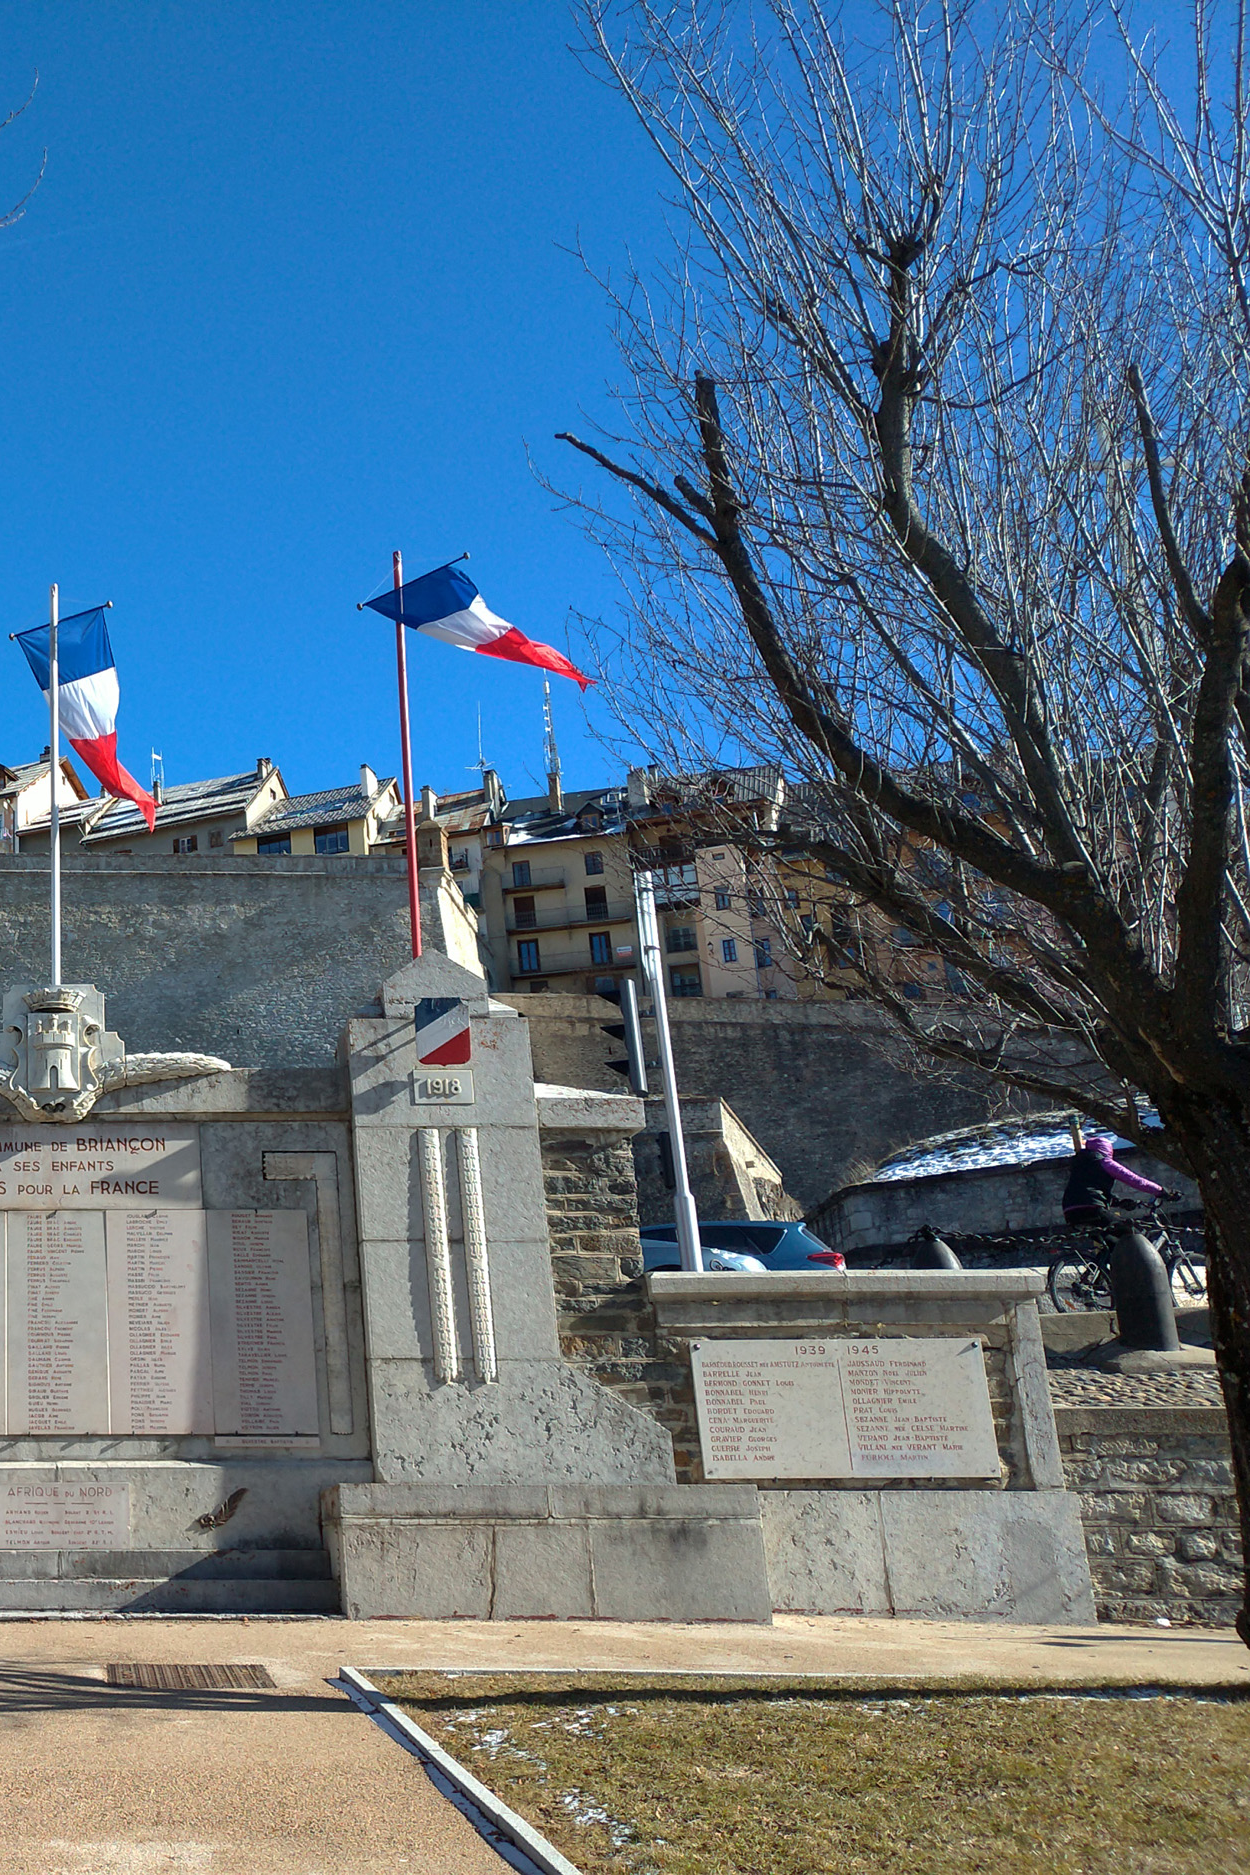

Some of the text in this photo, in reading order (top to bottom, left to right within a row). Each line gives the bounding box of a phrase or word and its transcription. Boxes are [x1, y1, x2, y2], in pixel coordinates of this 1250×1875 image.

[426, 1078, 462, 1095] 1918
[13, 1161, 40, 1172] SES
[51, 1161, 114, 1172] ENFANTS
[17, 1184, 53, 1195] POUR
[90, 1180, 159, 1195] FRANCE
[795, 1345, 879, 1355] 1939 1945
[7, 1486, 59, 1497] AFRIQUE
[79, 1486, 112, 1497] NORD
